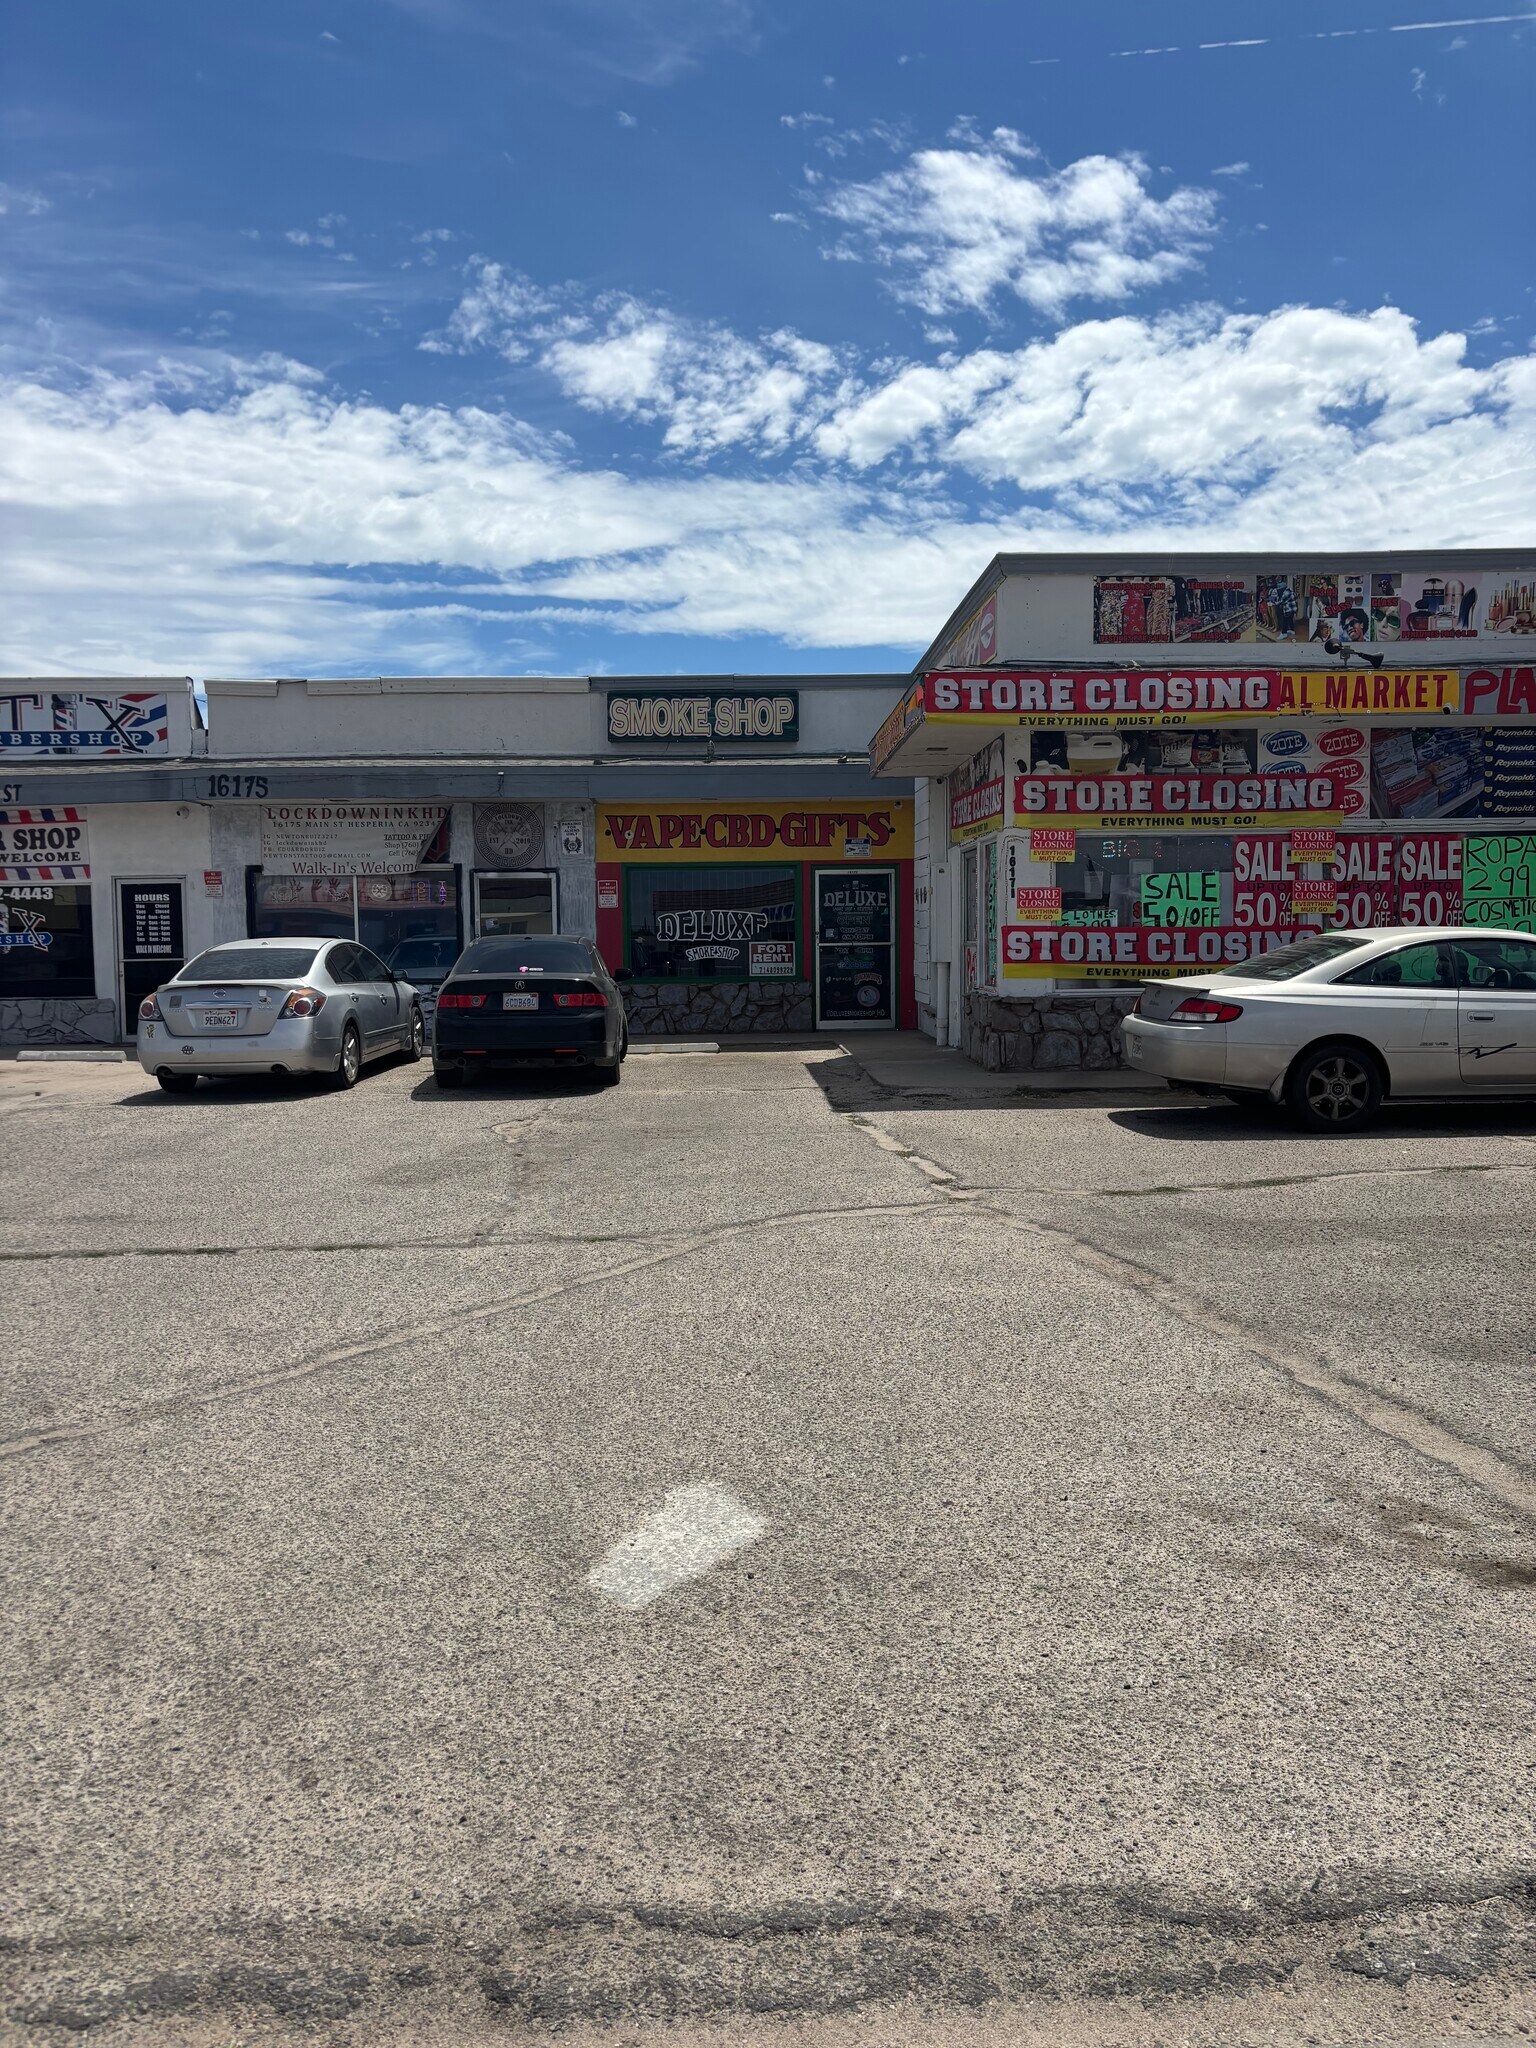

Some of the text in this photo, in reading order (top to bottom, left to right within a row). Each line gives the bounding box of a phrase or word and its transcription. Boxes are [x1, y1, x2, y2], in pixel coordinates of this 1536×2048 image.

[934, 676, 1270, 711] STORE CLOSING
[1325, 674, 1449, 709] MARKET
[610, 697, 795, 737] SMOKE SHOP
[1019, 715, 1187, 726] EVERYTHING MUST GO!
[1492, 729, 1534, 737] Reynolds
[0, 734, 142, 745] BERSHOP
[1270, 734, 1303, 752] ZOTE
[1324, 734, 1360, 752] ZOTE
[1494, 744, 1535, 752] Reynolds
[1494, 759, 1534, 767] Reynolds
[1494, 774, 1534, 782] Reynolds
[208, 774, 269, 798] 16175
[4, 784, 22, 802] ST
[1021, 780, 1152, 812] STORE
[1161, 778, 1333, 811] CLOSING
[1493, 789, 1534, 797] Reynolds
[1492, 804, 1534, 812] Reynolds
[1100, 815, 1257, 827] EVERYTHING MUST GO!
[605, 812, 891, 848] VAPE CBD GIFTS
[13, 827, 81, 850] SHOP
[384, 833, 411, 841] TATTOO
[516, 837, 531, 845] 2019
[1033, 831, 1073, 841] STORE
[1294, 831, 1333, 841] STORE
[1033, 841, 1074, 850] CLOSING
[1293, 841, 1333, 849] CLOSING
[1466, 836, 1536, 867] ROPA
[1235, 841, 1296, 882] SALE
[1332, 841, 1392, 881] SALE
[1400, 840, 1462, 881] SALE
[292, 861, 357, 875] Walk-In's
[1294, 882, 1335, 891] STORE
[1413, 882, 1453, 891] UP TO
[1467, 865, 1530, 897] 2.99
[1145, 873, 1218, 902] SALE
[1247, 883, 1287, 891] UP TO
[1343, 883, 1382, 891] UP TO
[134, 894, 170, 902] HOURS
[823, 890, 888, 907] DELUXE
[1019, 889, 1059, 900] STORE
[1294, 891, 1334, 900] CLOSING
[1019, 899, 1059, 908] CLOSING
[1400, 891, 1445, 927] 50
[1234, 892, 1277, 927] 50
[1330, 891, 1371, 928] 50
[1279, 912, 1296, 926] OFF
[1373, 911, 1391, 927] OFF
[1446, 911, 1463, 926] OFF
[757, 944, 787, 953] FOR
[1007, 930, 1317, 962] STORE CLOSIN
[753, 953, 791, 962] RENT
[1087, 968, 1213, 978] EVERYTHING MUST
[205, 1016, 236, 1026] 9EDN627
